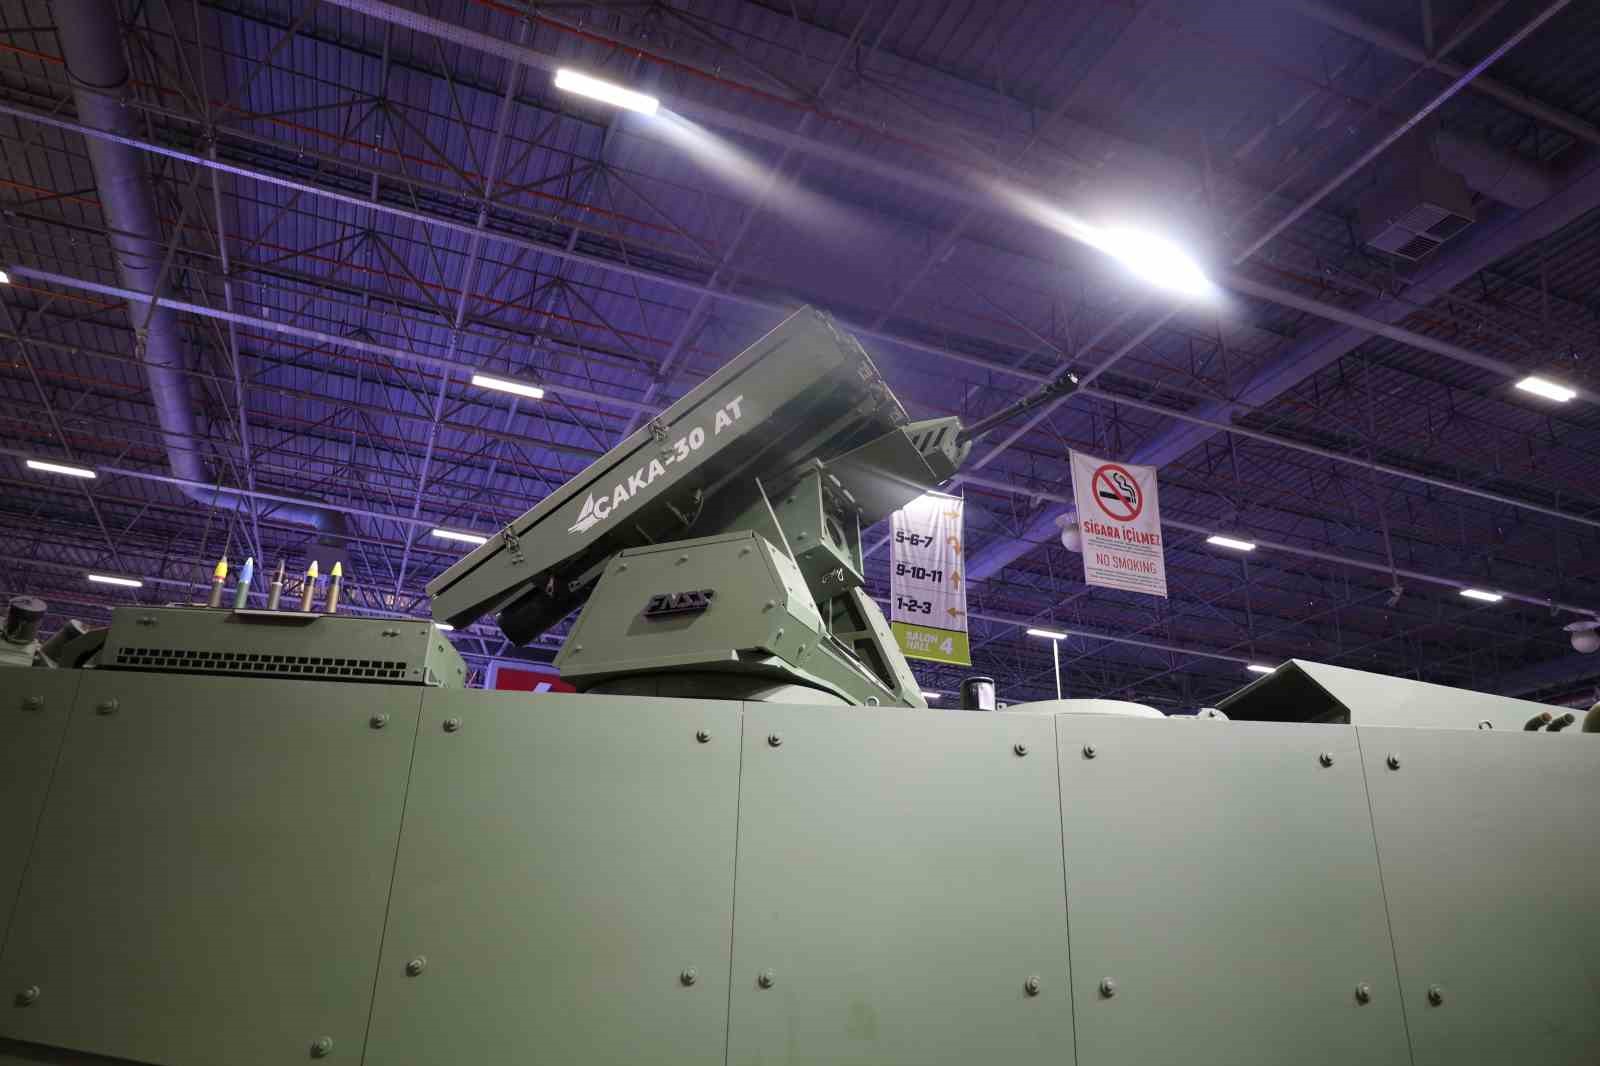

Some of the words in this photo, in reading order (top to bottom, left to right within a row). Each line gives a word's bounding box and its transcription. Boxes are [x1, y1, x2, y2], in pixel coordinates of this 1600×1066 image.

[714, 394, 744, 435] AT
[895, 531, 934, 548] 5-6-7
[1095, 553, 1110, 567] NO
[1112, 556, 1157, 574] SMOKING
[895, 563, 943, 584] 9-10-11
[896, 597, 933, 615] 1-2-3
[939, 637, 953, 655] 4
